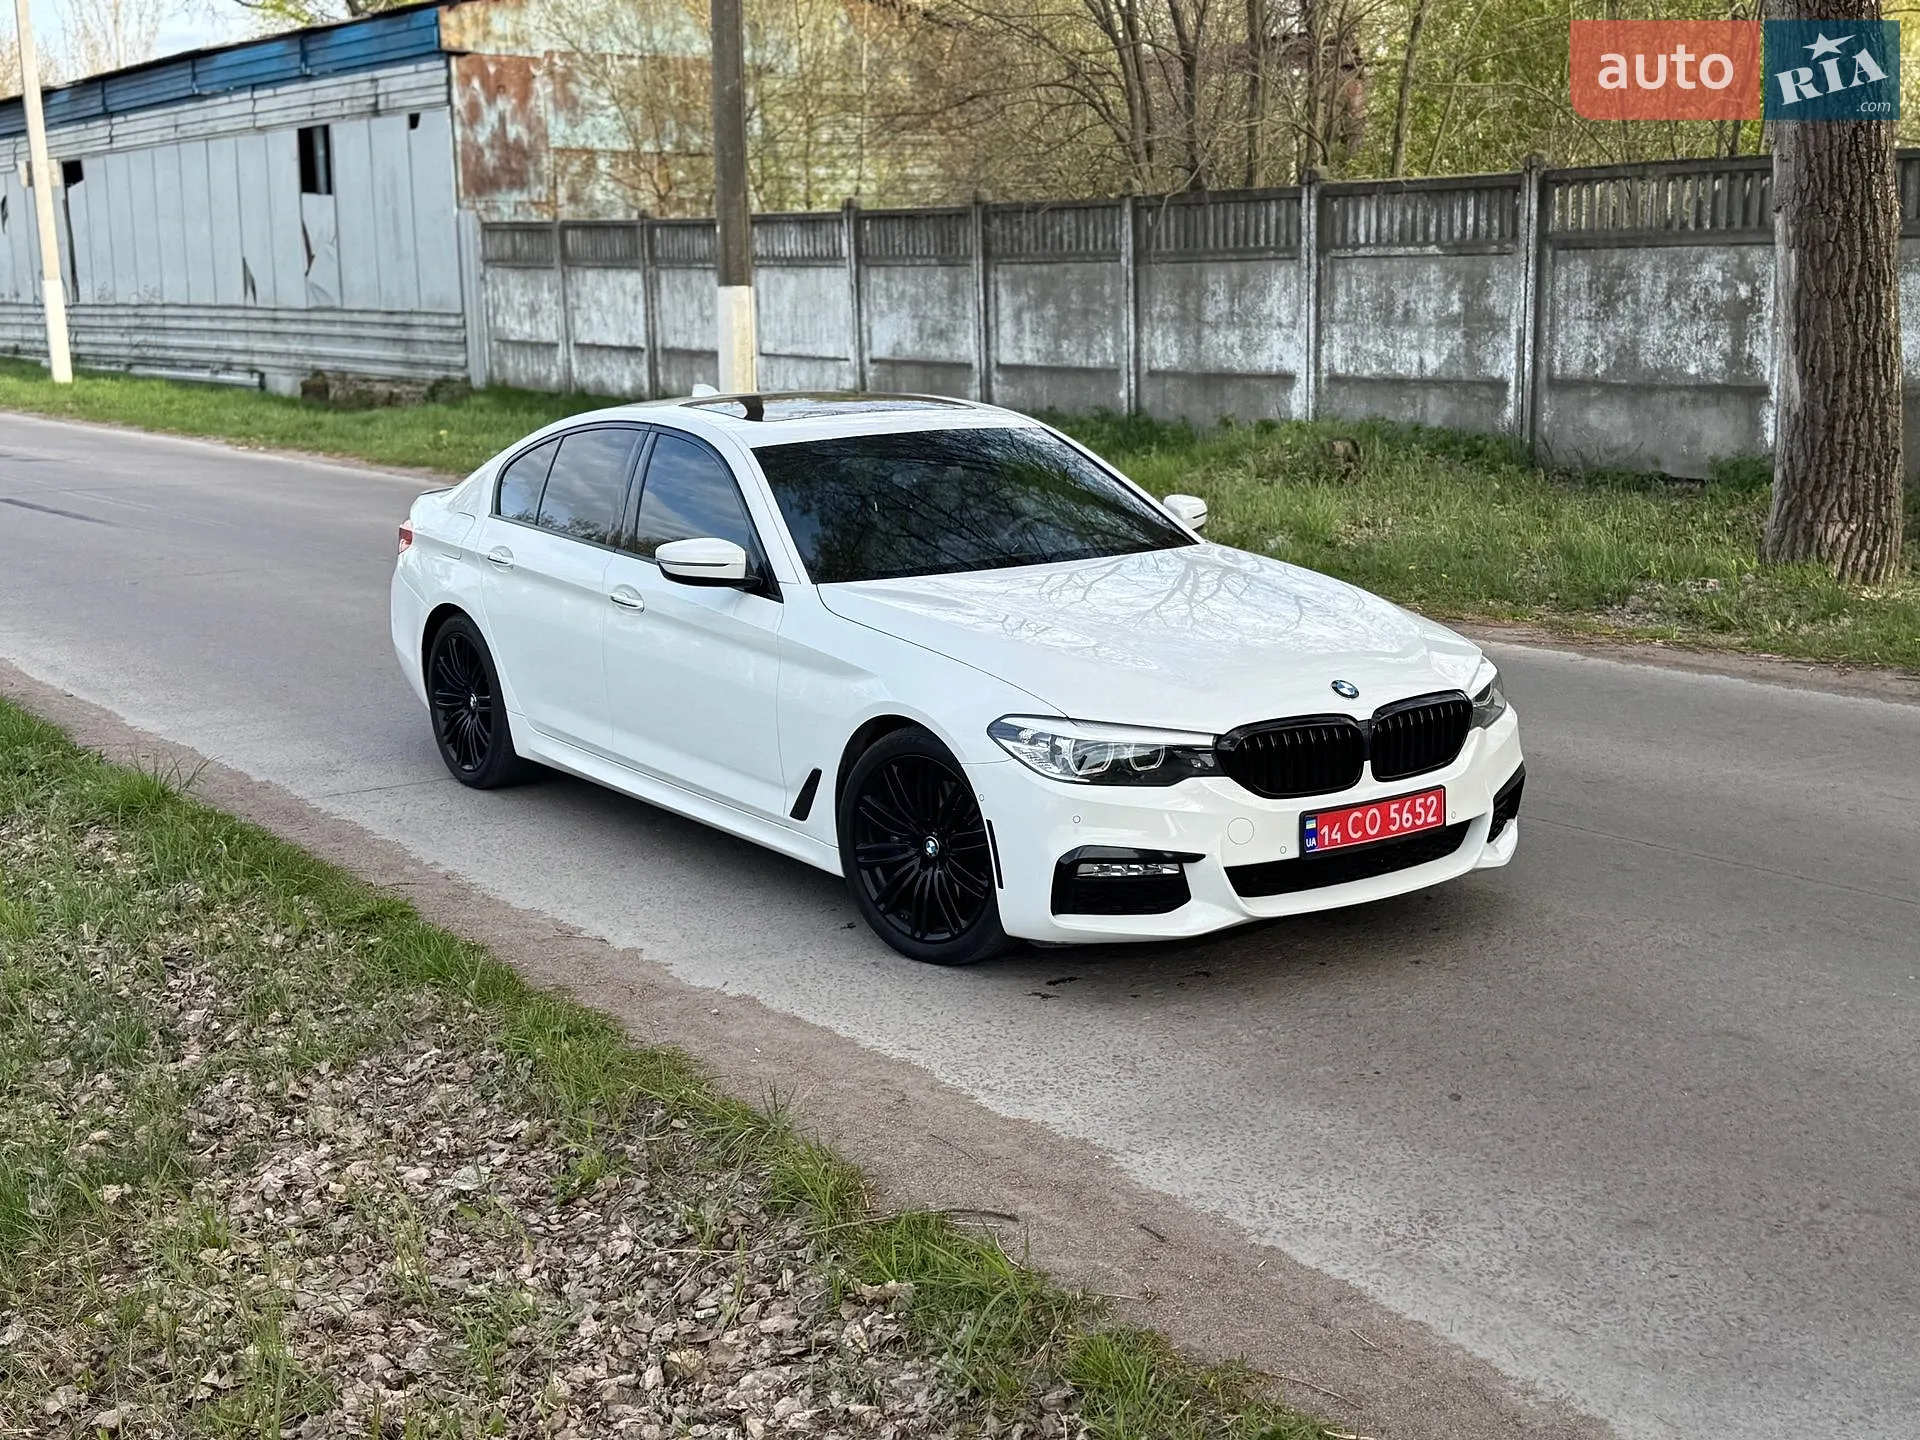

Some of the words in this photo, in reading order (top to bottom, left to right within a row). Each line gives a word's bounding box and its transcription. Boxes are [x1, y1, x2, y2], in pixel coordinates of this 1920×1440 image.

[1320, 822, 1341, 846] 14
[1347, 807, 1381, 839] CO
[1388, 795, 1437, 832] 5652
[1305, 837, 1317, 848] UA
